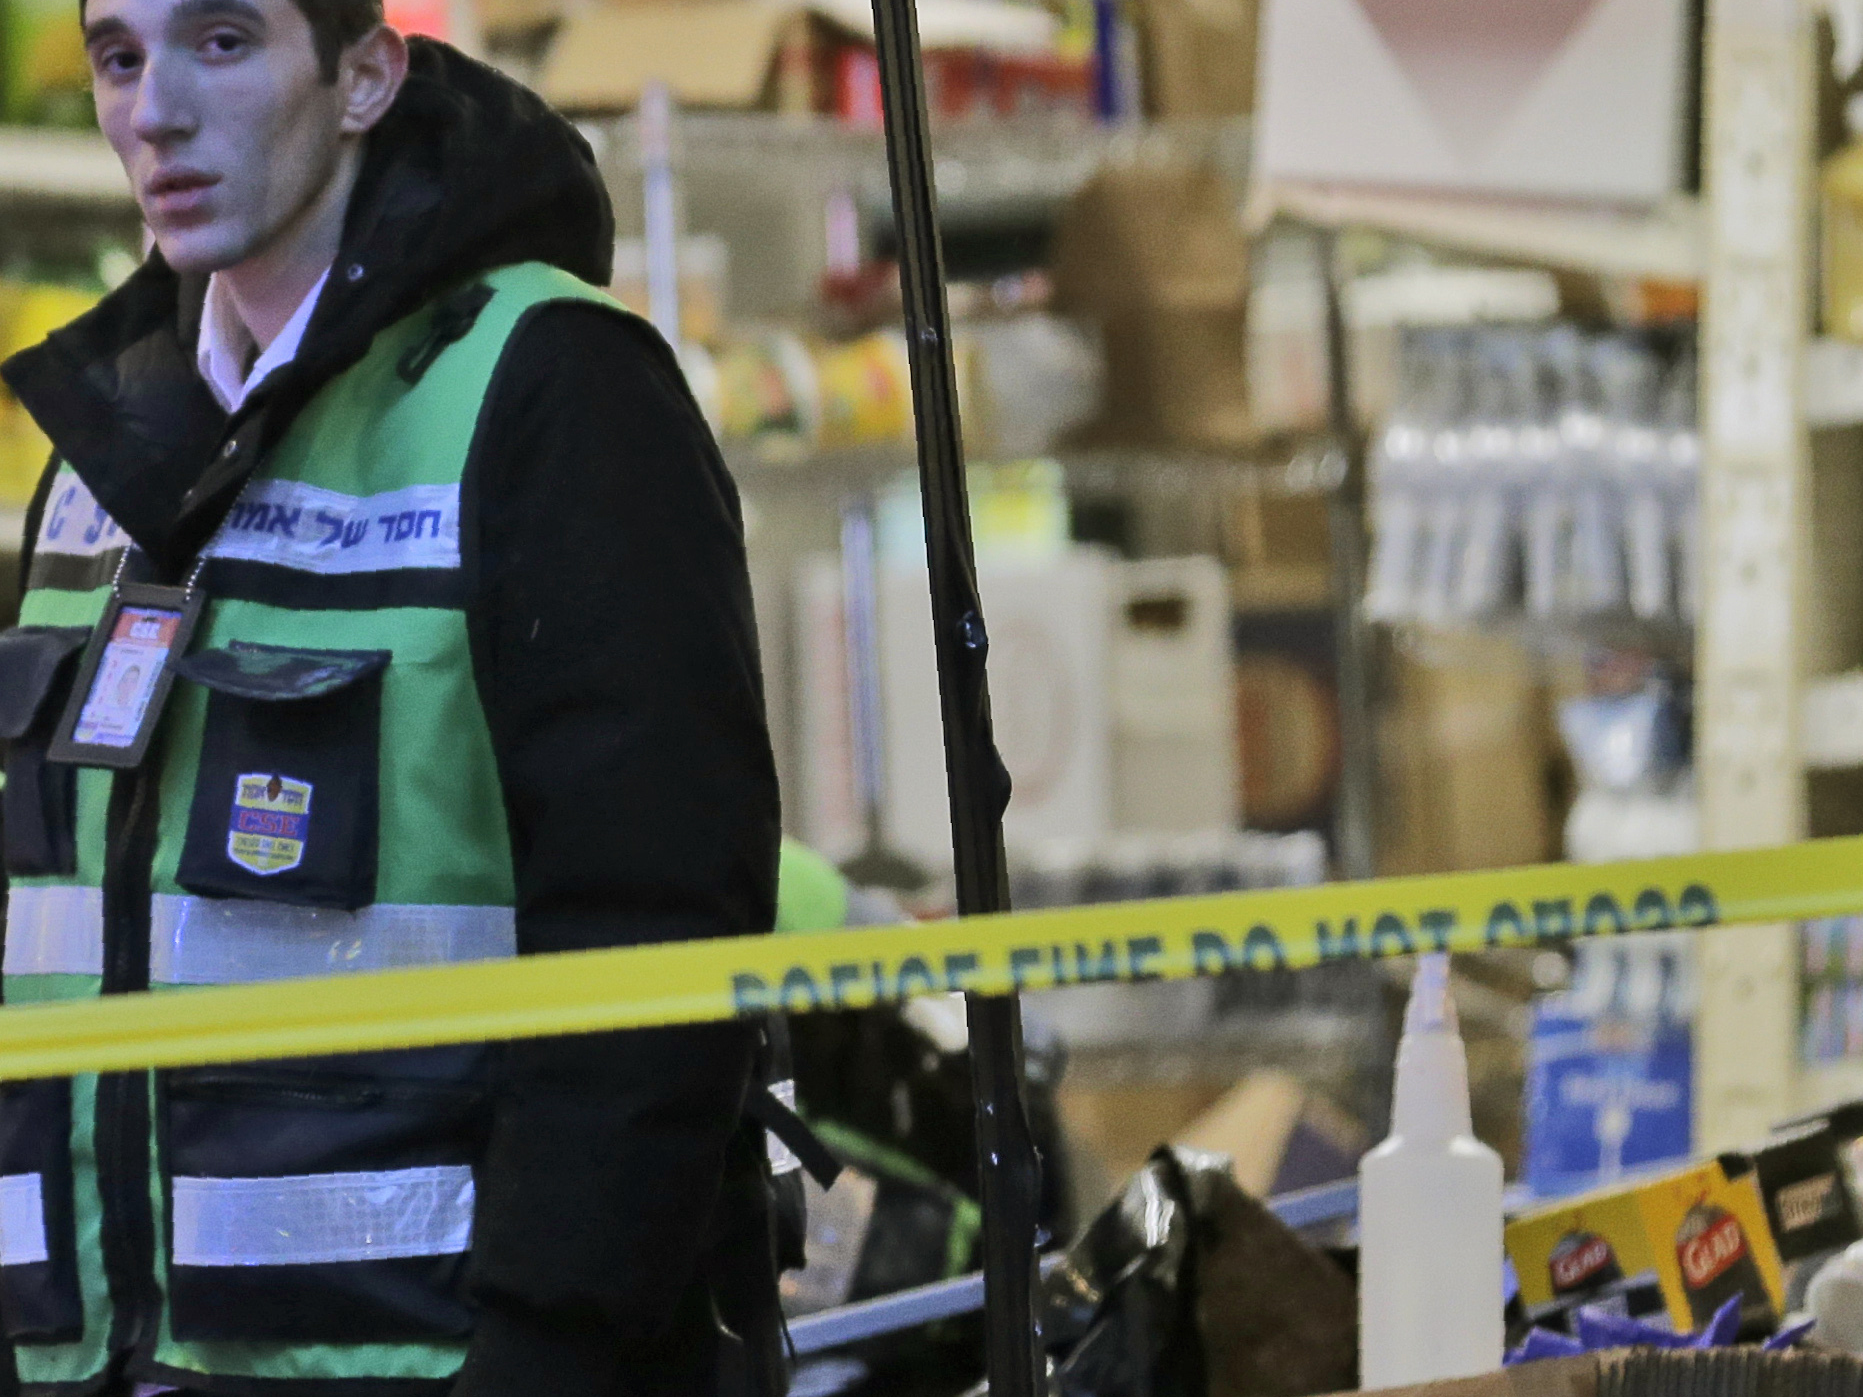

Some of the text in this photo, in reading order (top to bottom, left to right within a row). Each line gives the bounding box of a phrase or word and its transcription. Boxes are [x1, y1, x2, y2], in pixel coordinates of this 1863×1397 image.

[315, 510, 369, 549] של
[378, 509, 442, 545] חסד
[238, 811, 300, 837] CSE
